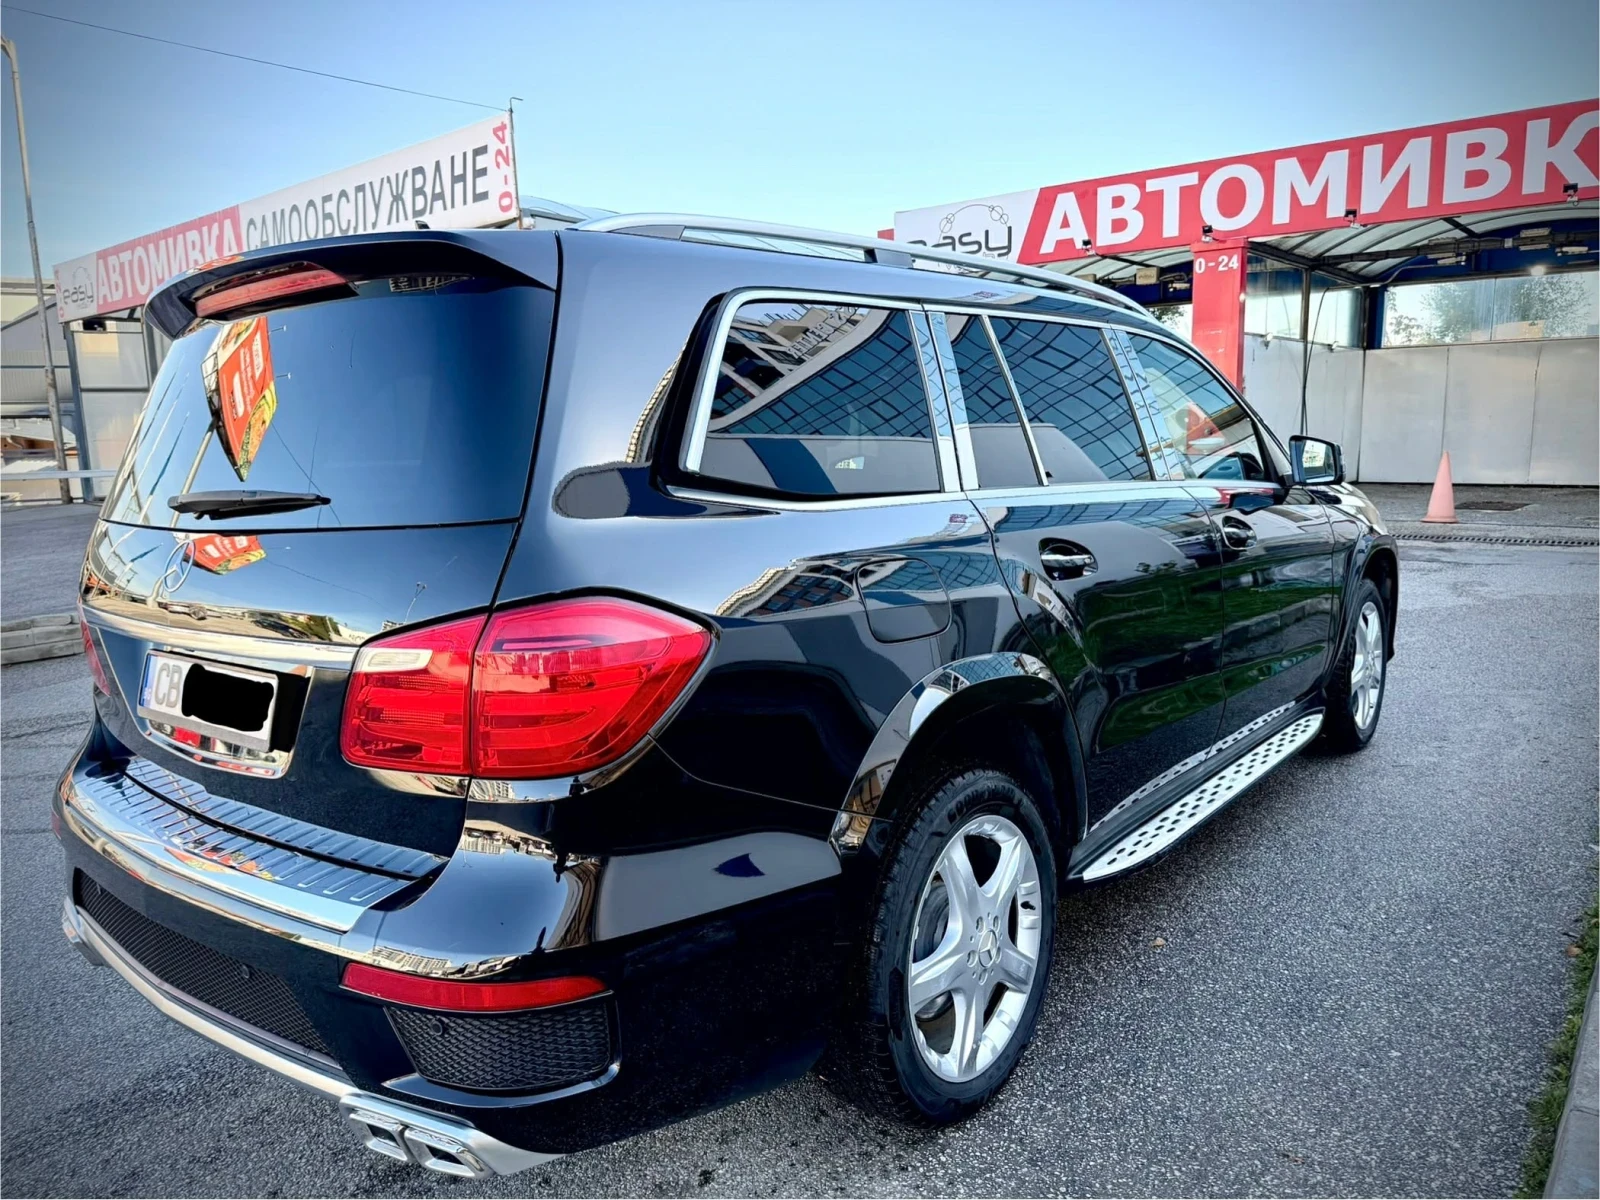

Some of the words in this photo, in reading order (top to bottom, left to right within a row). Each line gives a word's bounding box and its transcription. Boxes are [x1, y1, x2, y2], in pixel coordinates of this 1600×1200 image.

[246, 144, 489, 251] САМООБСЛУЖВАНЕ
[1039, 110, 1599, 255] АВТОМИВК
[62, 281, 94, 305] easy
[98, 218, 238, 305] АВТОМИВКА
